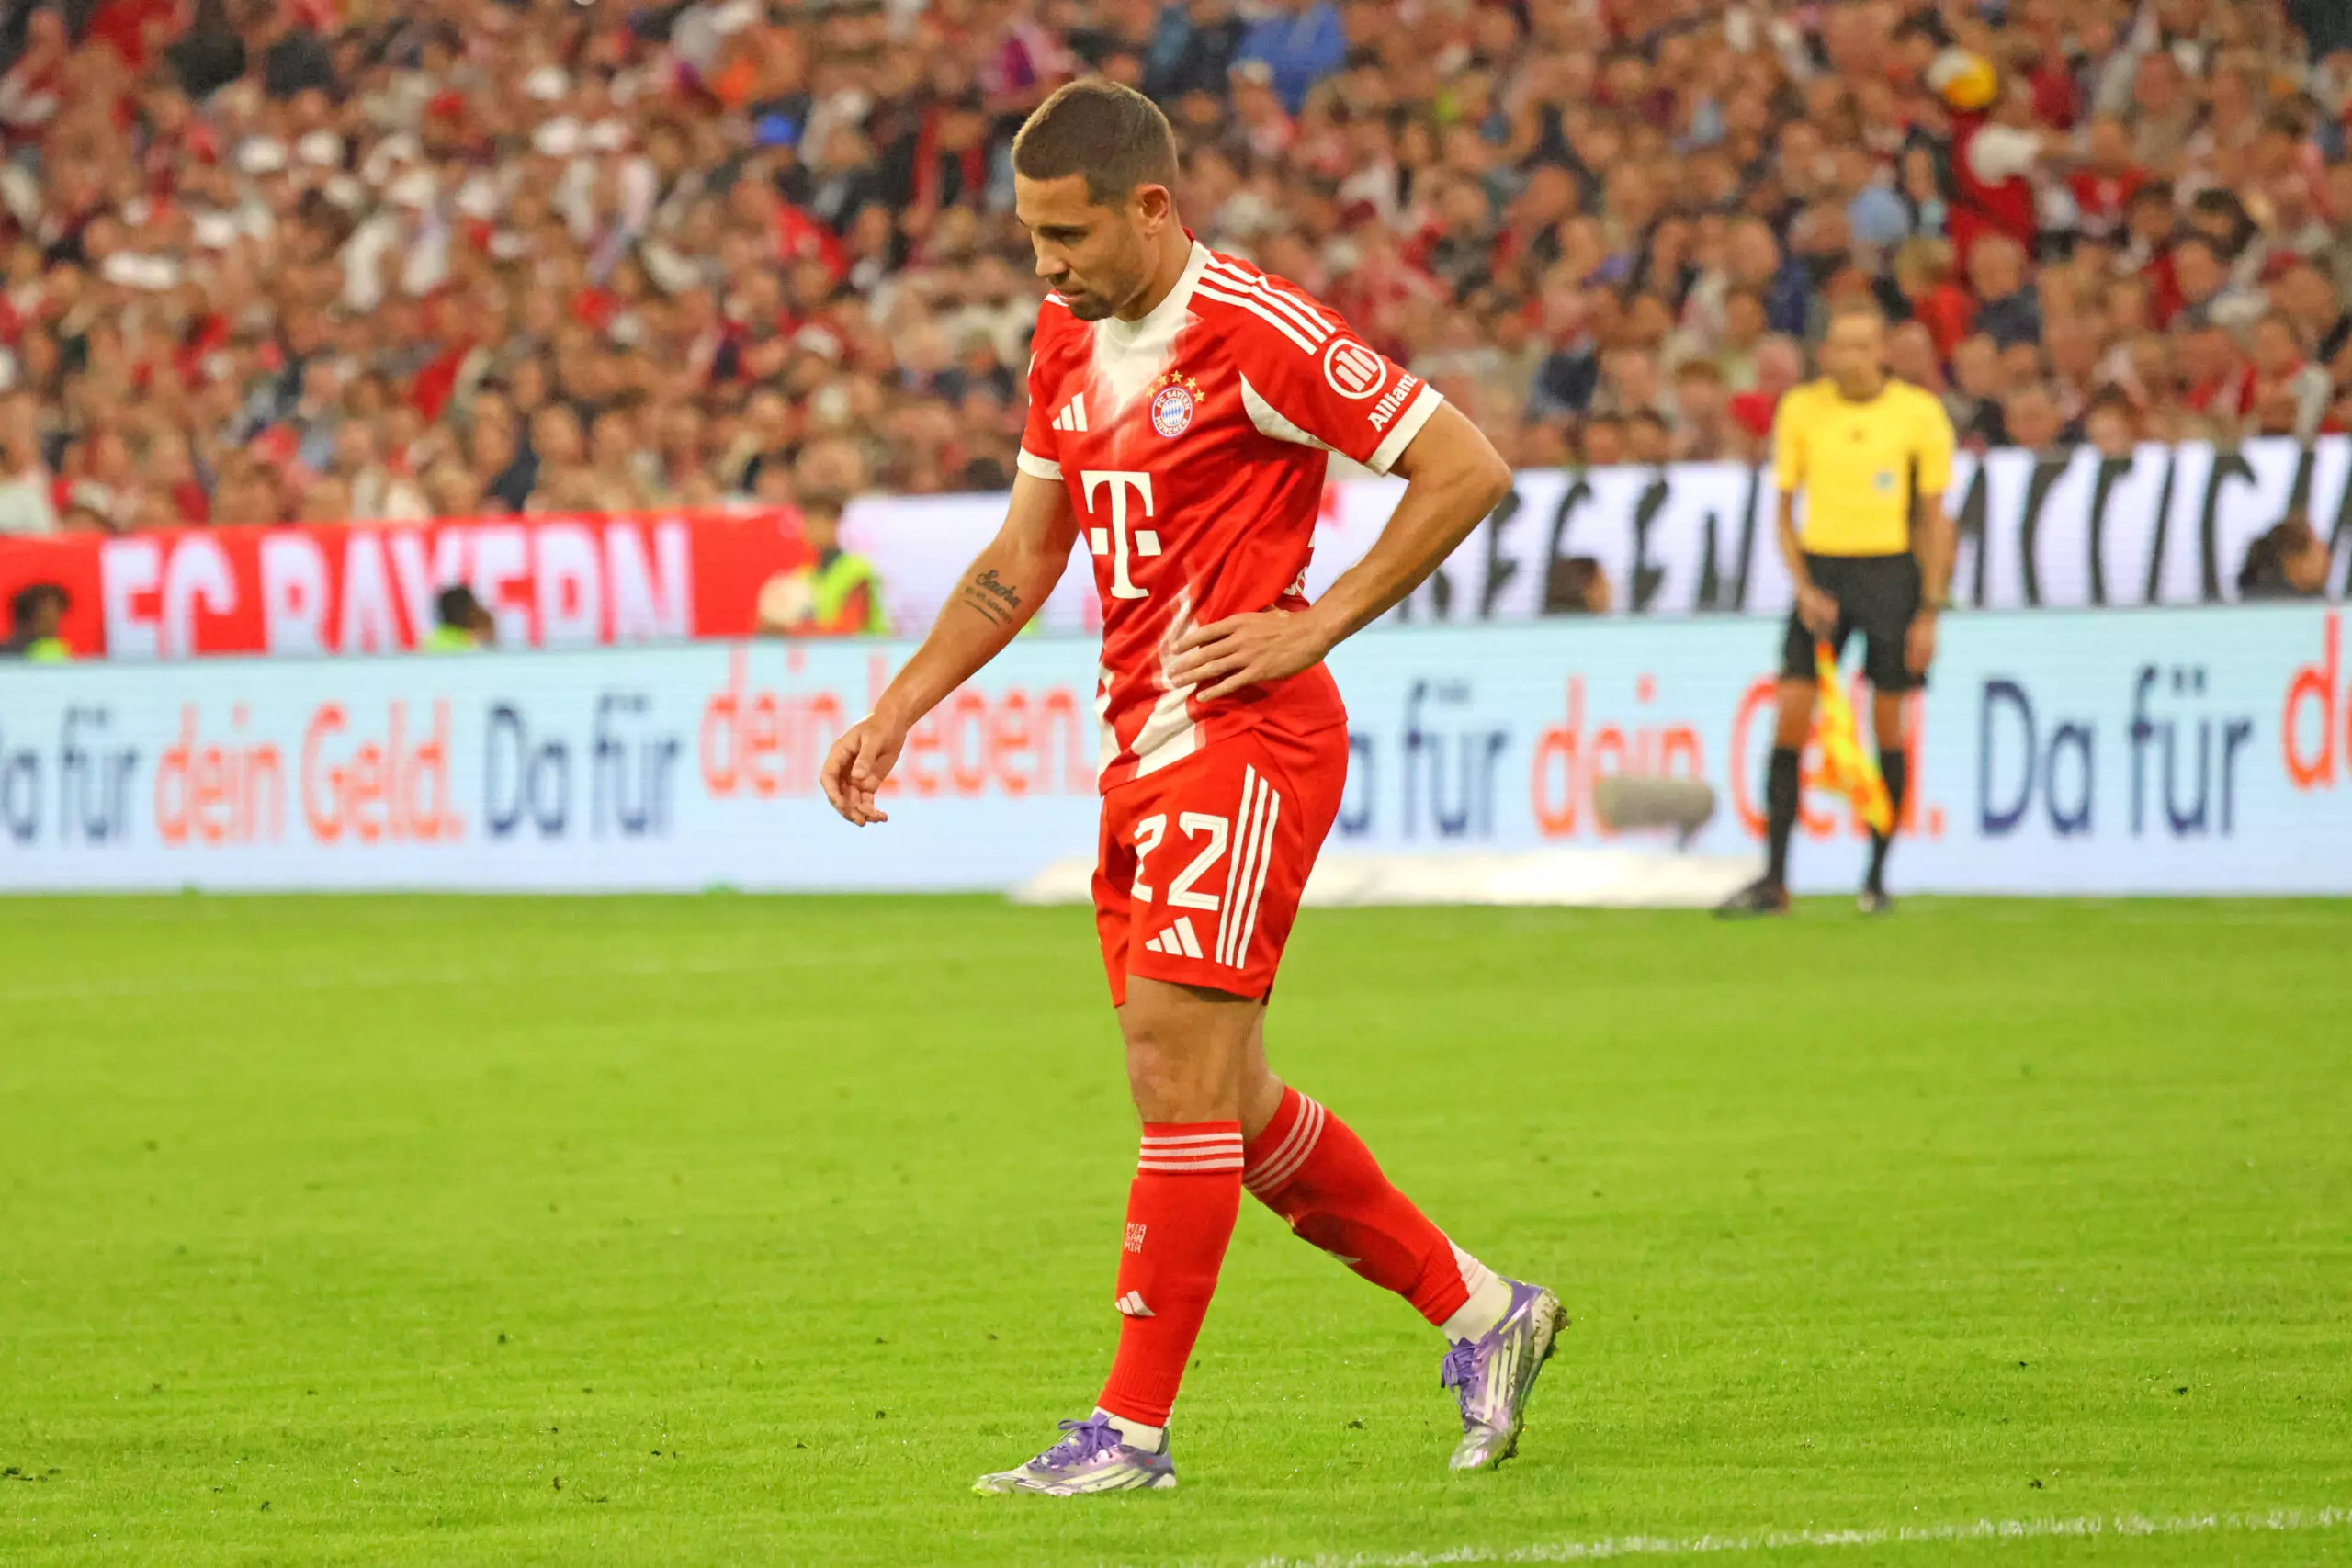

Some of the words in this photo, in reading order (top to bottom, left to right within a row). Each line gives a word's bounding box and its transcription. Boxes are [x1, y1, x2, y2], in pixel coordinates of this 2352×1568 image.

[1156, 395, 1166, 408] FC
[1165, 389, 1192, 410] BAYERN
[1367, 373, 1418, 433] Allianz
[100, 533, 238, 660] FC
[260, 520, 693, 657] BAYERN
[0, 713, 39, 847] a
[58, 704, 140, 847] für
[153, 702, 285, 848] dein
[301, 700, 465, 844] Geld.
[485, 699, 571, 841] Da
[592, 694, 684, 841] für
[699, 641, 845, 799] dein
[1402, 678, 1510, 840] für
[1978, 675, 2098, 839] Da
[2130, 664, 2254, 839] für
[2279, 613, 2352, 791] d
[1131, 811, 1229, 911] 22
[1126, 1222, 1147, 1235] MIA
